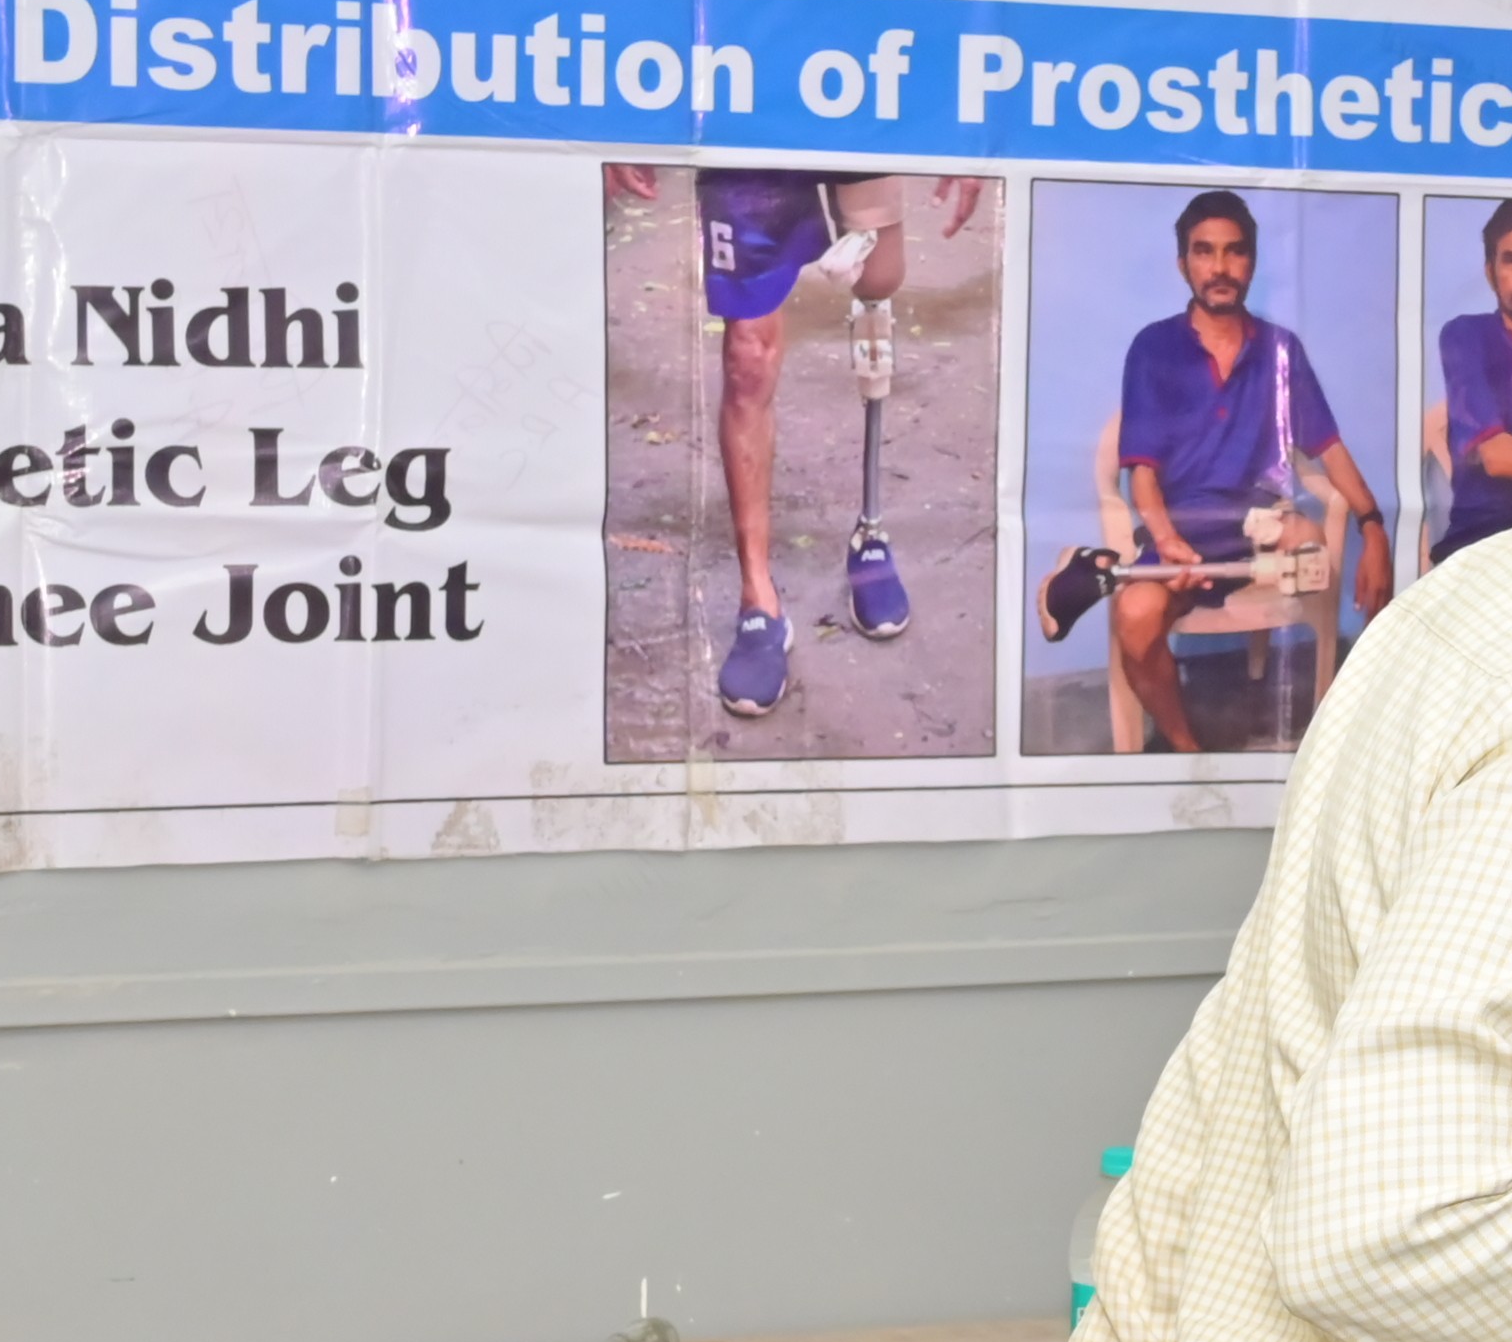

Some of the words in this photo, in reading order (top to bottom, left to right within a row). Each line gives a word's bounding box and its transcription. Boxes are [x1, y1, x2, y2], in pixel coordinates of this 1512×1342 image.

[801, 31, 912, 118] of
[70, 278, 360, 369] Nidhi
[250, 429, 450, 531] Leg
[193, 556, 483, 644] Joint
